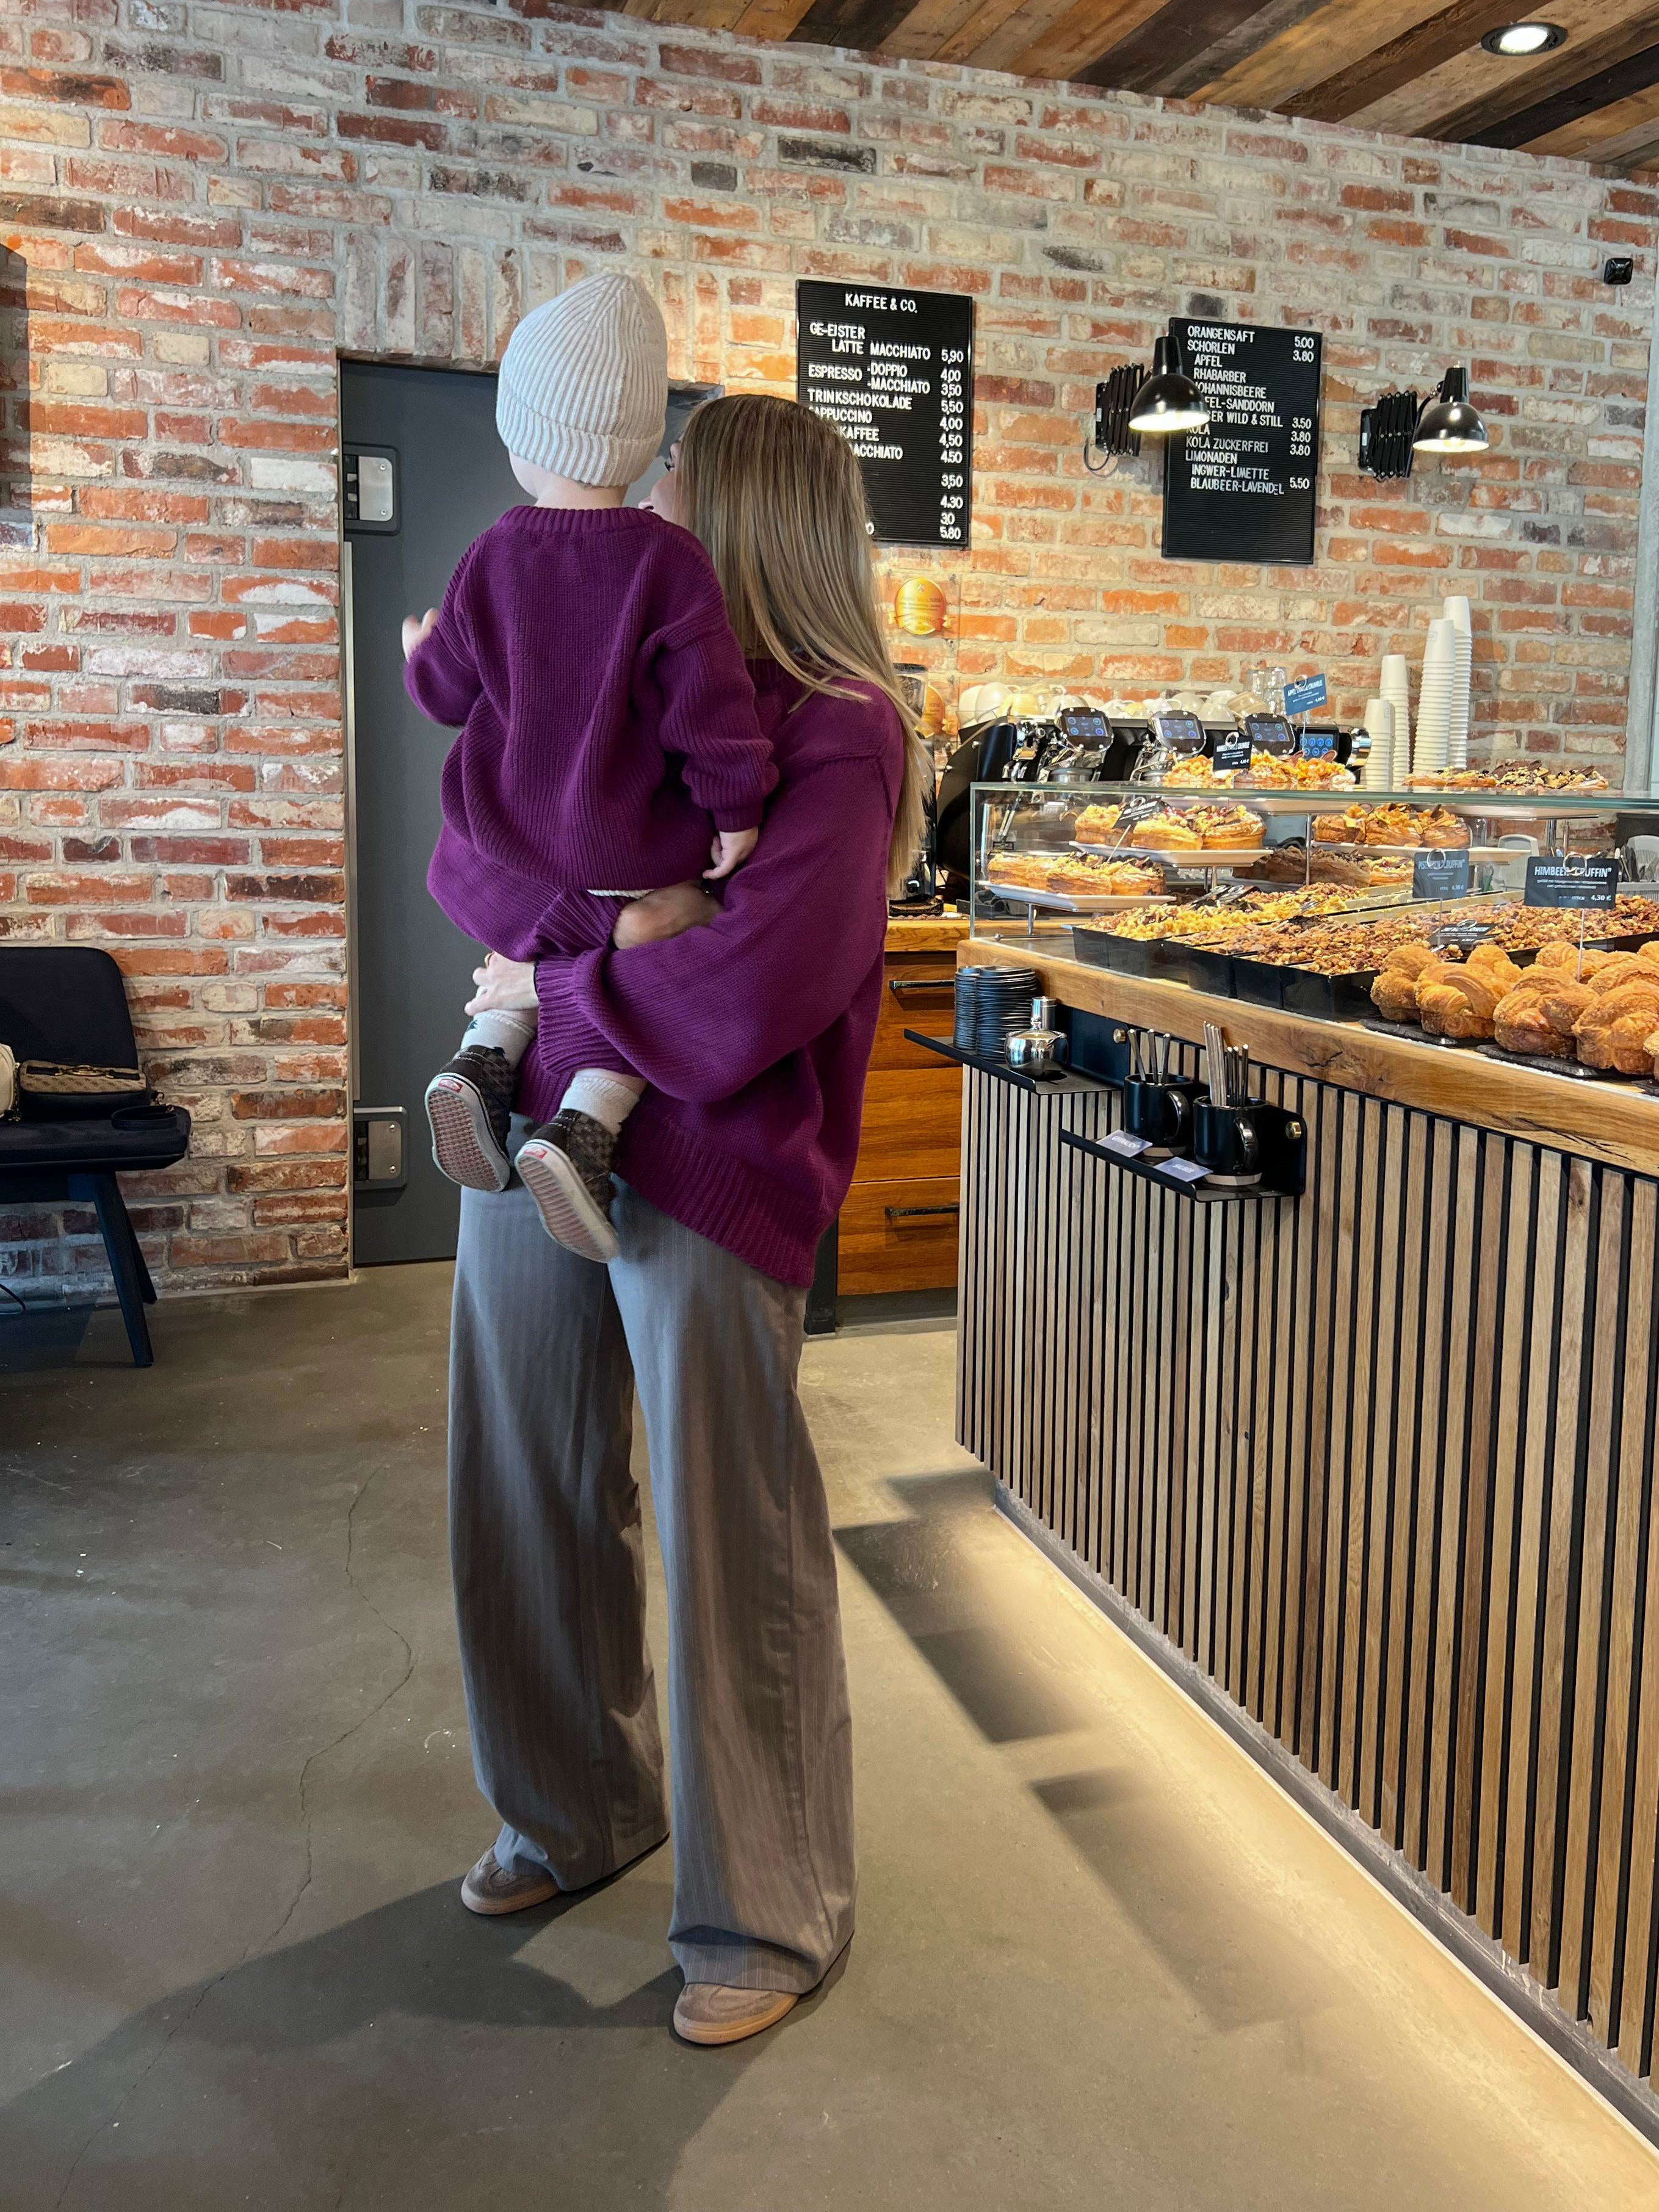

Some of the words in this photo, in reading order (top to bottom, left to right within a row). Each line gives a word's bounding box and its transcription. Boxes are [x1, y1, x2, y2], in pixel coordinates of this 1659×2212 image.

[845, 294, 887, 309] KAFFEE
[889, 298, 898, 311] &
[900, 299, 918, 313] CO.
[809, 322, 866, 339] GE-EISTER
[1187, 325, 1255, 343] ORANGENSAFT
[831, 338, 864, 355] LATTE
[870, 342, 931, 360] MACCHIATO
[1187, 339, 1235, 355] SCHORLEN
[1194, 353, 1223, 367] APFEL
[808, 364, 862, 381] ESPRESSO
[1193, 367, 1246, 383] RHABARBER
[807, 388, 913, 410] TRINKSCHOKOLADE
[1227, 412, 1249, 424] WILD
[1251, 413, 1258, 425] &
[1259, 415, 1284, 427] STILL
[850, 443, 903, 460] ACCHIATO
[1186, 436, 1210, 449] KOLA
[1213, 438, 1268, 454] ZUCKERFREI
[1185, 450, 1237, 464] LIMONADEN
[1191, 464, 1270, 480] INGWER-LIMETTE
[1190, 477, 1284, 496] BLAUBEER-LAVENDEL
